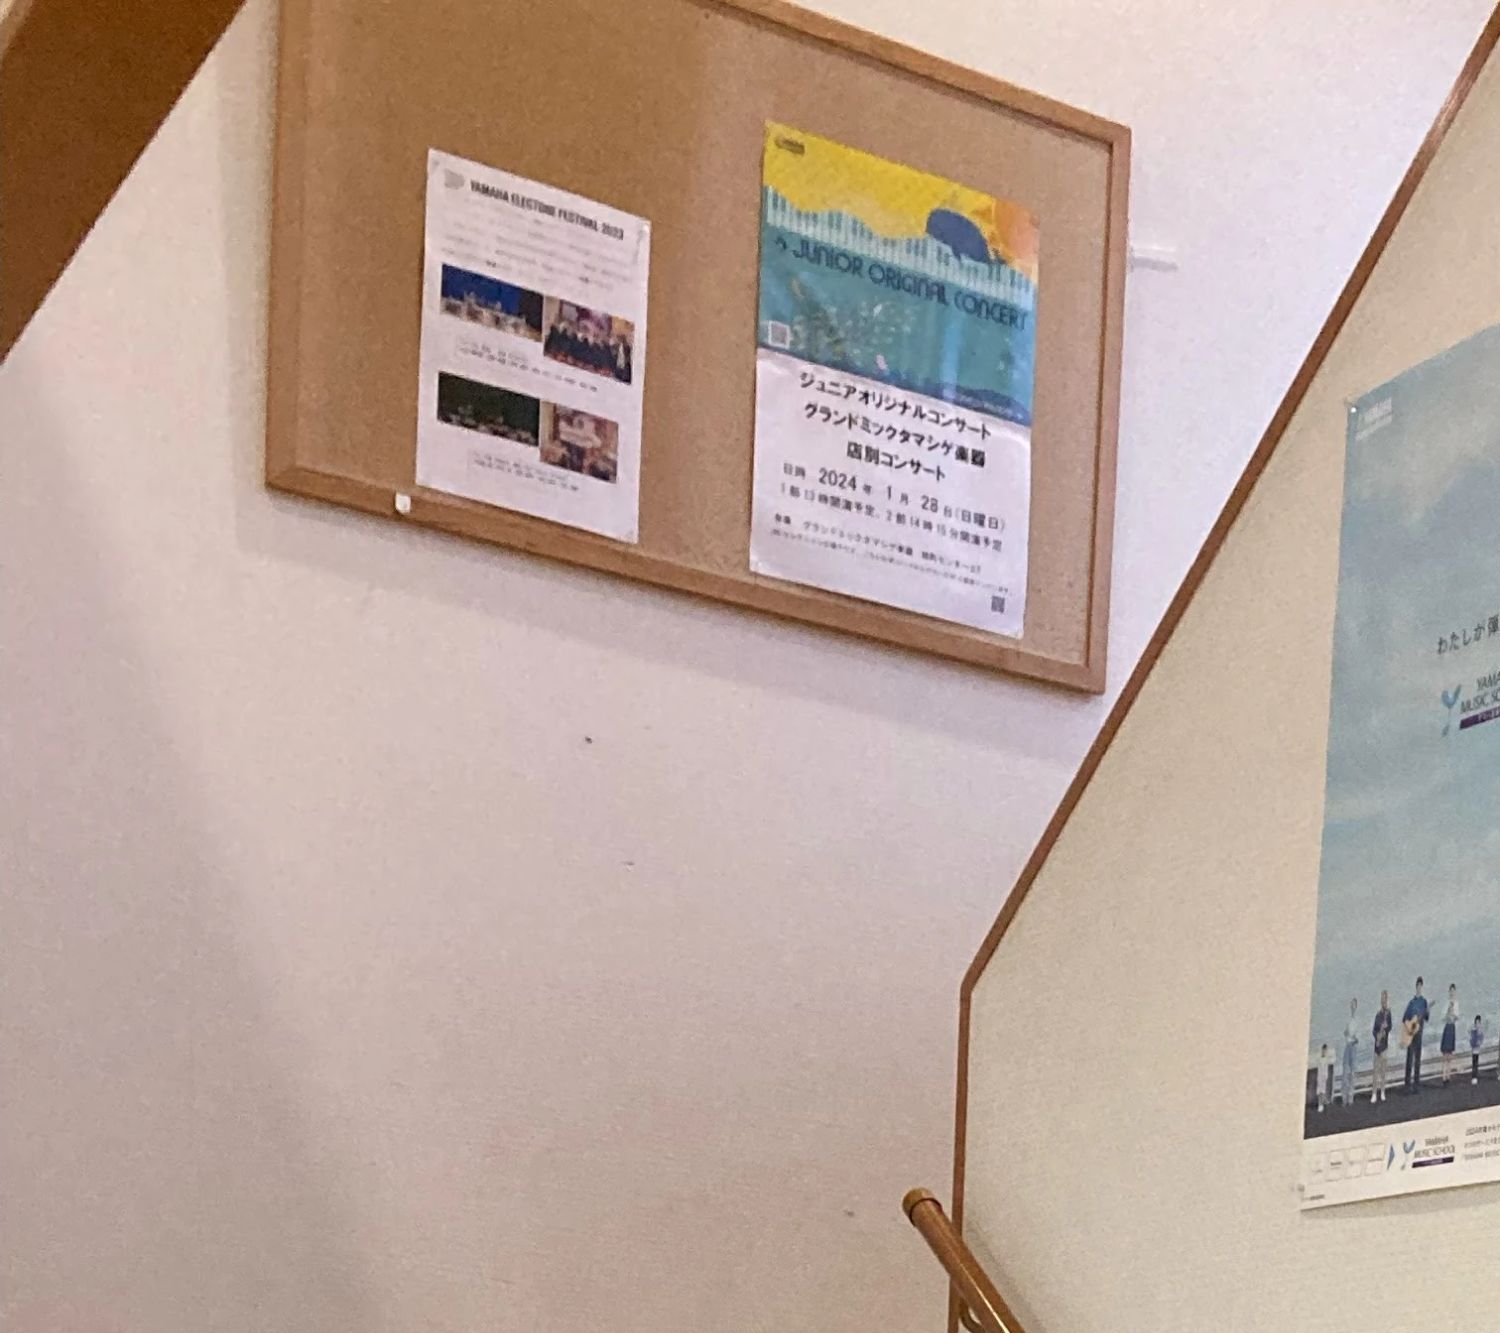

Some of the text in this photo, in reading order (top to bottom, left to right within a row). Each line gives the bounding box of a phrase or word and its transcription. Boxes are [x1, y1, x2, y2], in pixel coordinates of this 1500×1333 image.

[792, 240, 1026, 331] JUNIOR ORIGINAL CONCERT
[800, 372, 991, 439] ジュニアオリジナルコンサート
